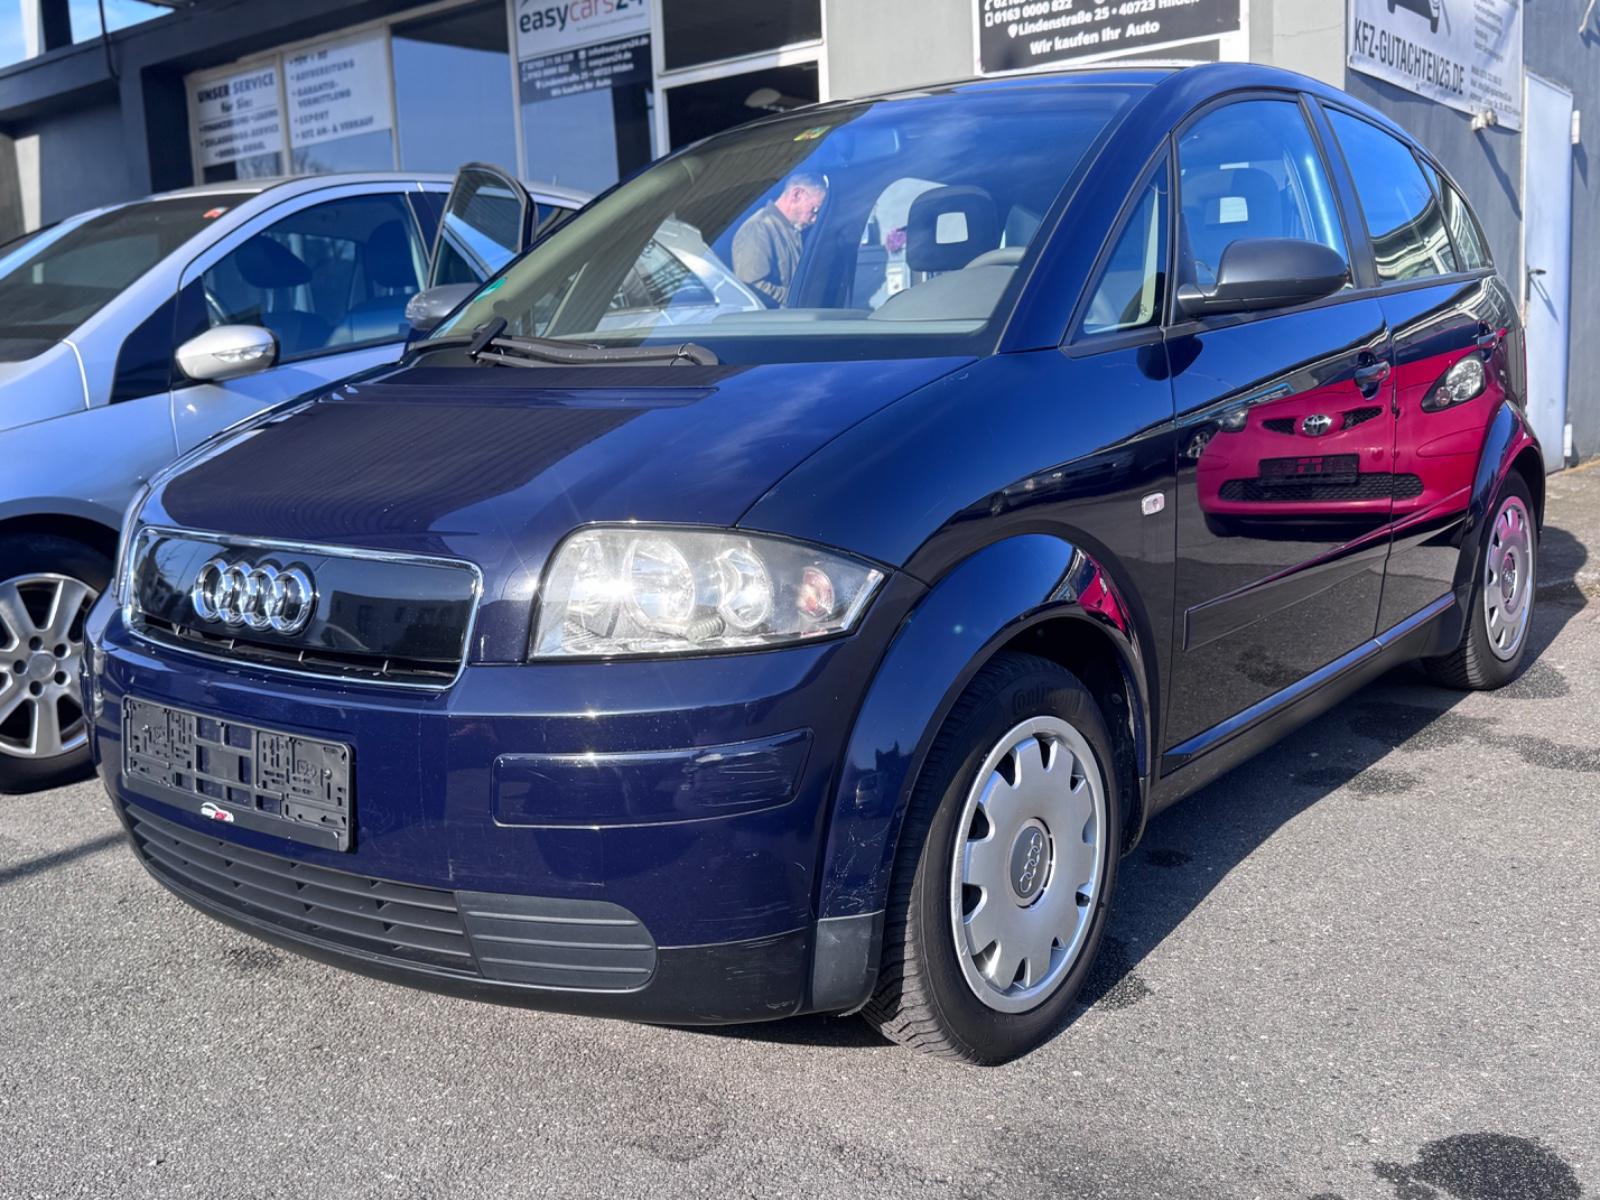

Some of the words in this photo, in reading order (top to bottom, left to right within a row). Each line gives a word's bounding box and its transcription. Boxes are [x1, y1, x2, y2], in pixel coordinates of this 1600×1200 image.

[518, 0, 643, 33] easycars
[994, 7, 1020, 24] 0163
[1022, 1, 1050, 17] 0000
[1018, 10, 1093, 36] Lindenstraße
[1094, 6, 1109, 21] 25
[1119, 0, 1155, 16] 40723
[1030, 38, 1053, 55] Wir
[1054, 31, 1099, 51] kaufen
[1101, 26, 1121, 42] Ihr
[1125, 20, 1160, 38] Auto
[1354, 17, 1465, 96] KFZ-GUTACHTEN25.DE
[197, 83, 229, 104] UNSER
[233, 72, 275, 95] SERVICE
